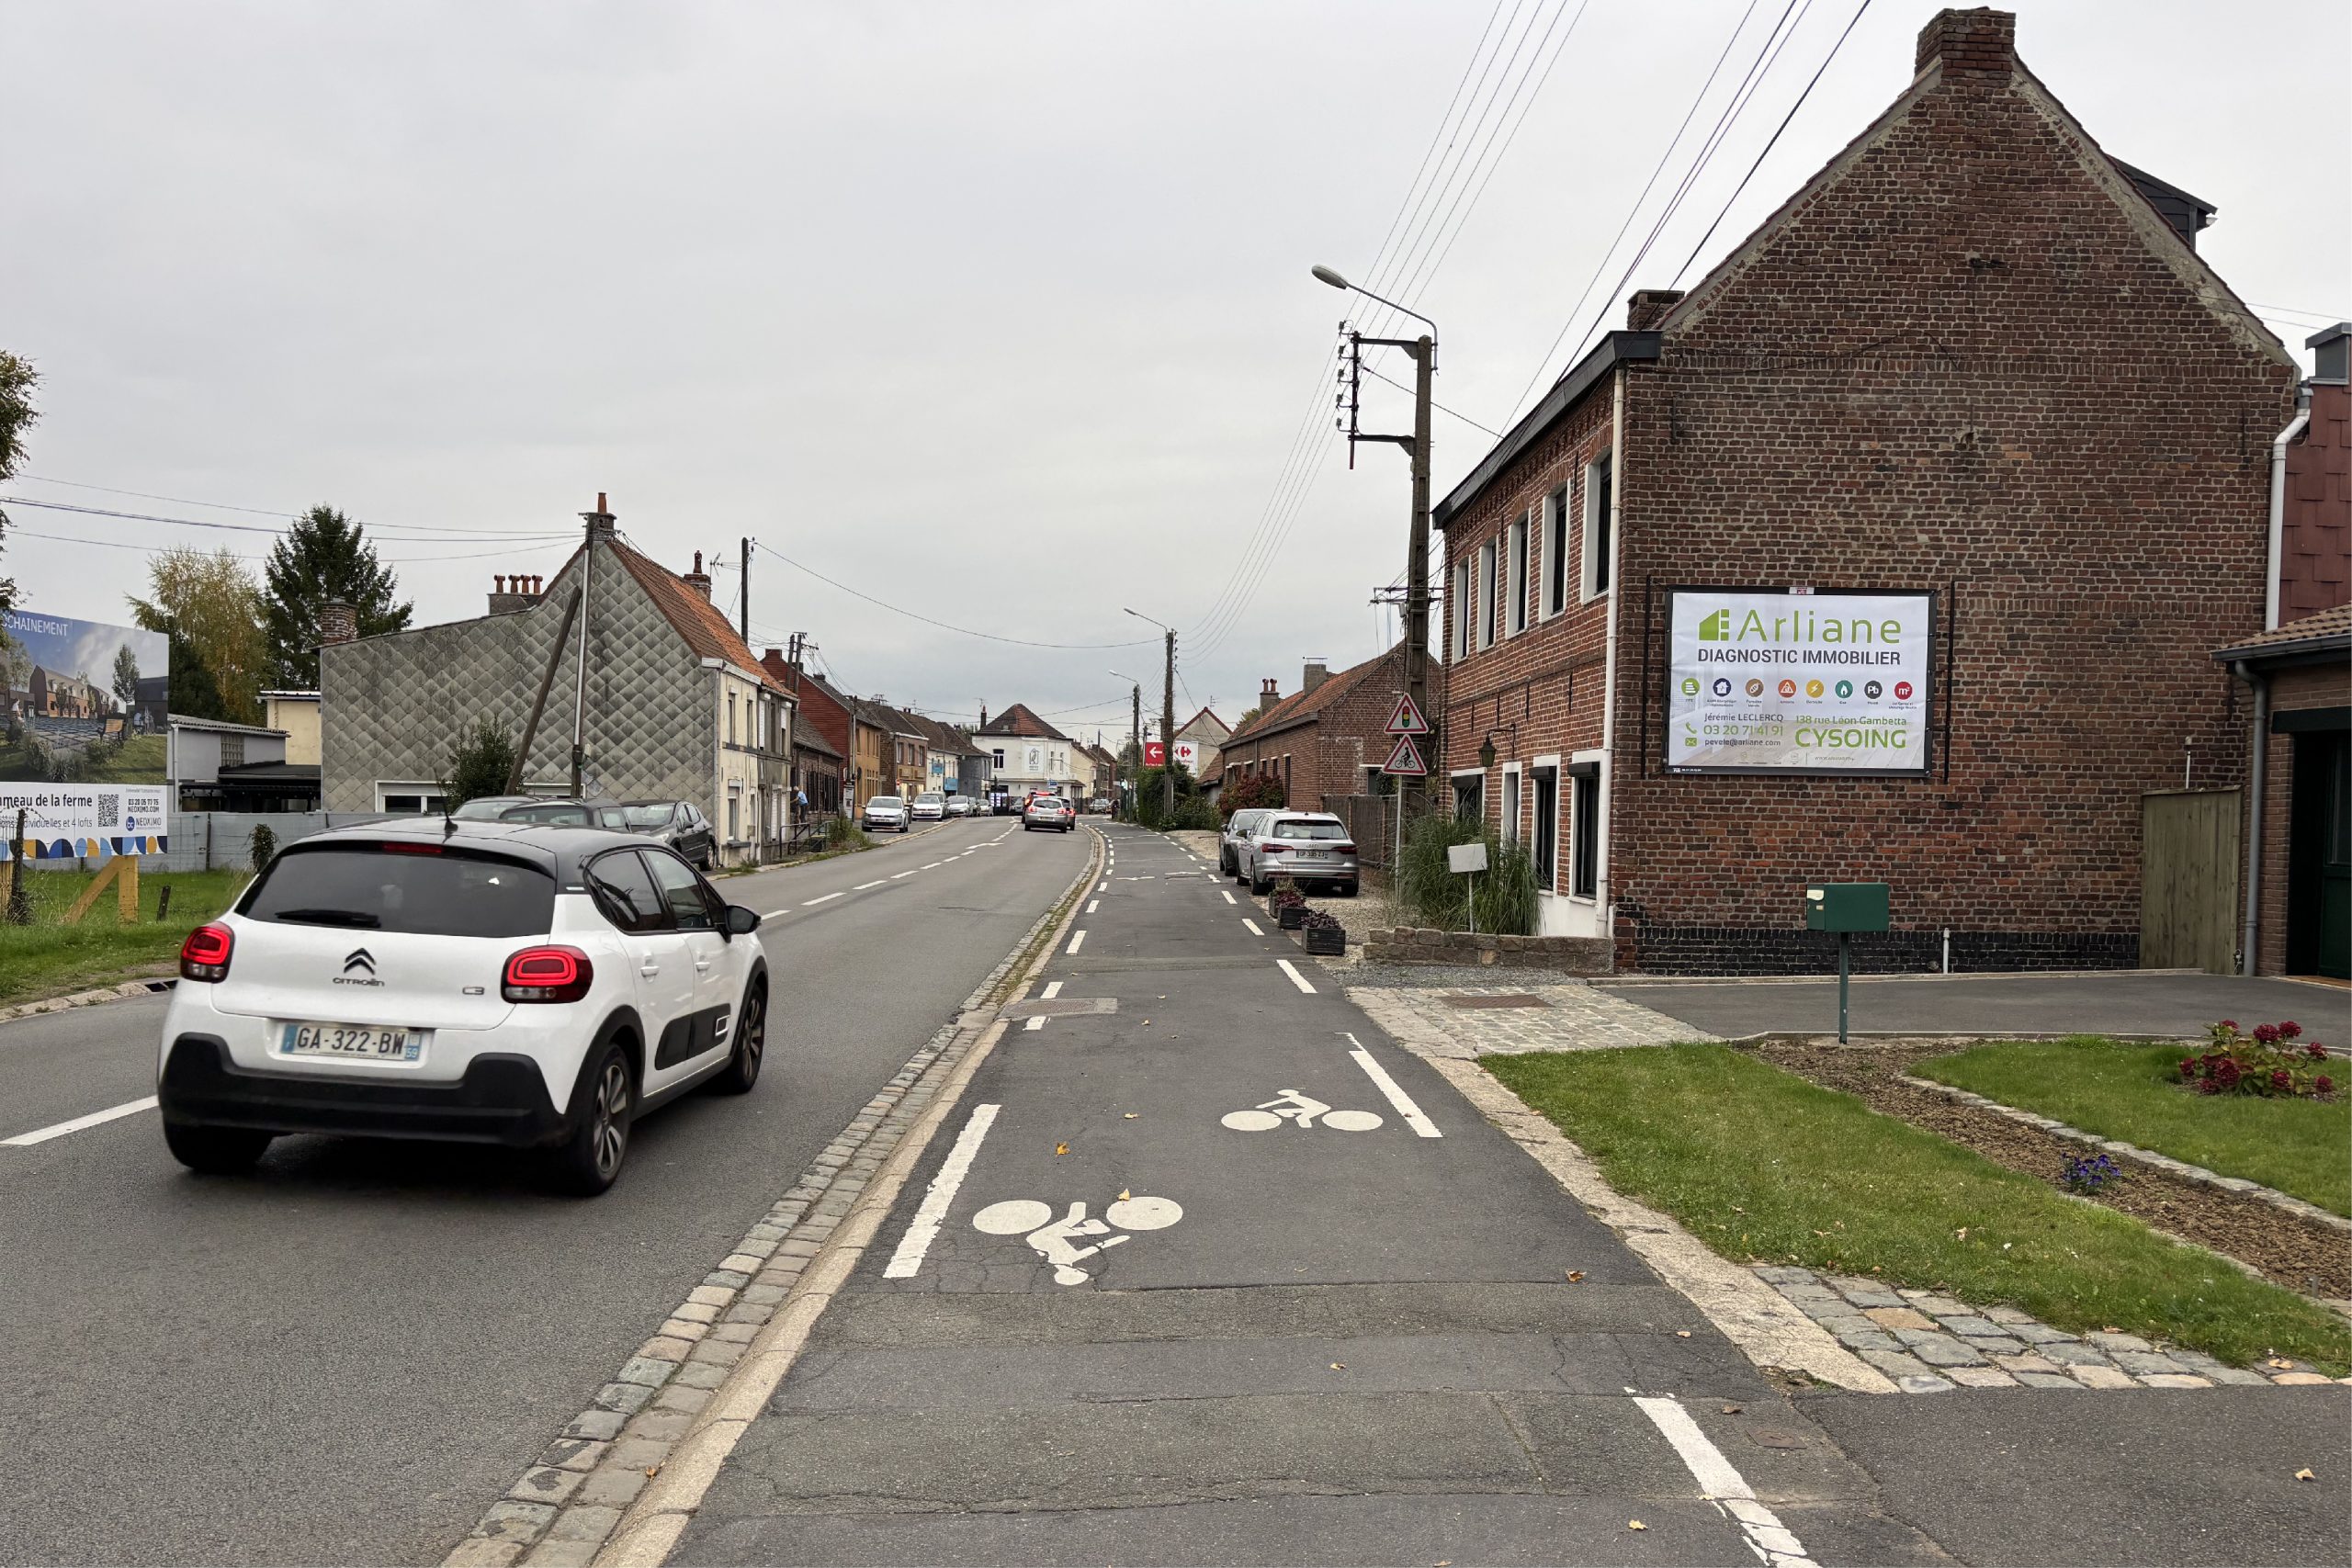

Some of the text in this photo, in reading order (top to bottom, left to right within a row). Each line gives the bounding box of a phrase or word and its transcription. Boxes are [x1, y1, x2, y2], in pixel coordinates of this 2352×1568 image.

[1736, 609, 1902, 644] Arliane
[1698, 649, 1901, 665] DIAGNOSTIC IMMOBILIER
[1703, 712, 1784, 723] Jérémie LECLERCQ
[1795, 715, 1812, 725] 138
[1815, 716, 1830, 725] rue
[1703, 725, 1720, 736] 03
[1723, 725, 1739, 736] 20
[1771, 725, 1783, 736] 91
[1794, 728, 1907, 749] CYSOING
[0, 794, 93, 807] meau de la ferme
[62, 818, 70, 828] et
[71, 818, 76, 828] 4
[77, 817, 93, 828] lofts
[462, 986, 485, 996] C3
[297, 1027, 406, 1055] GA-322-BW
[406, 1047, 418, 1058] 59
